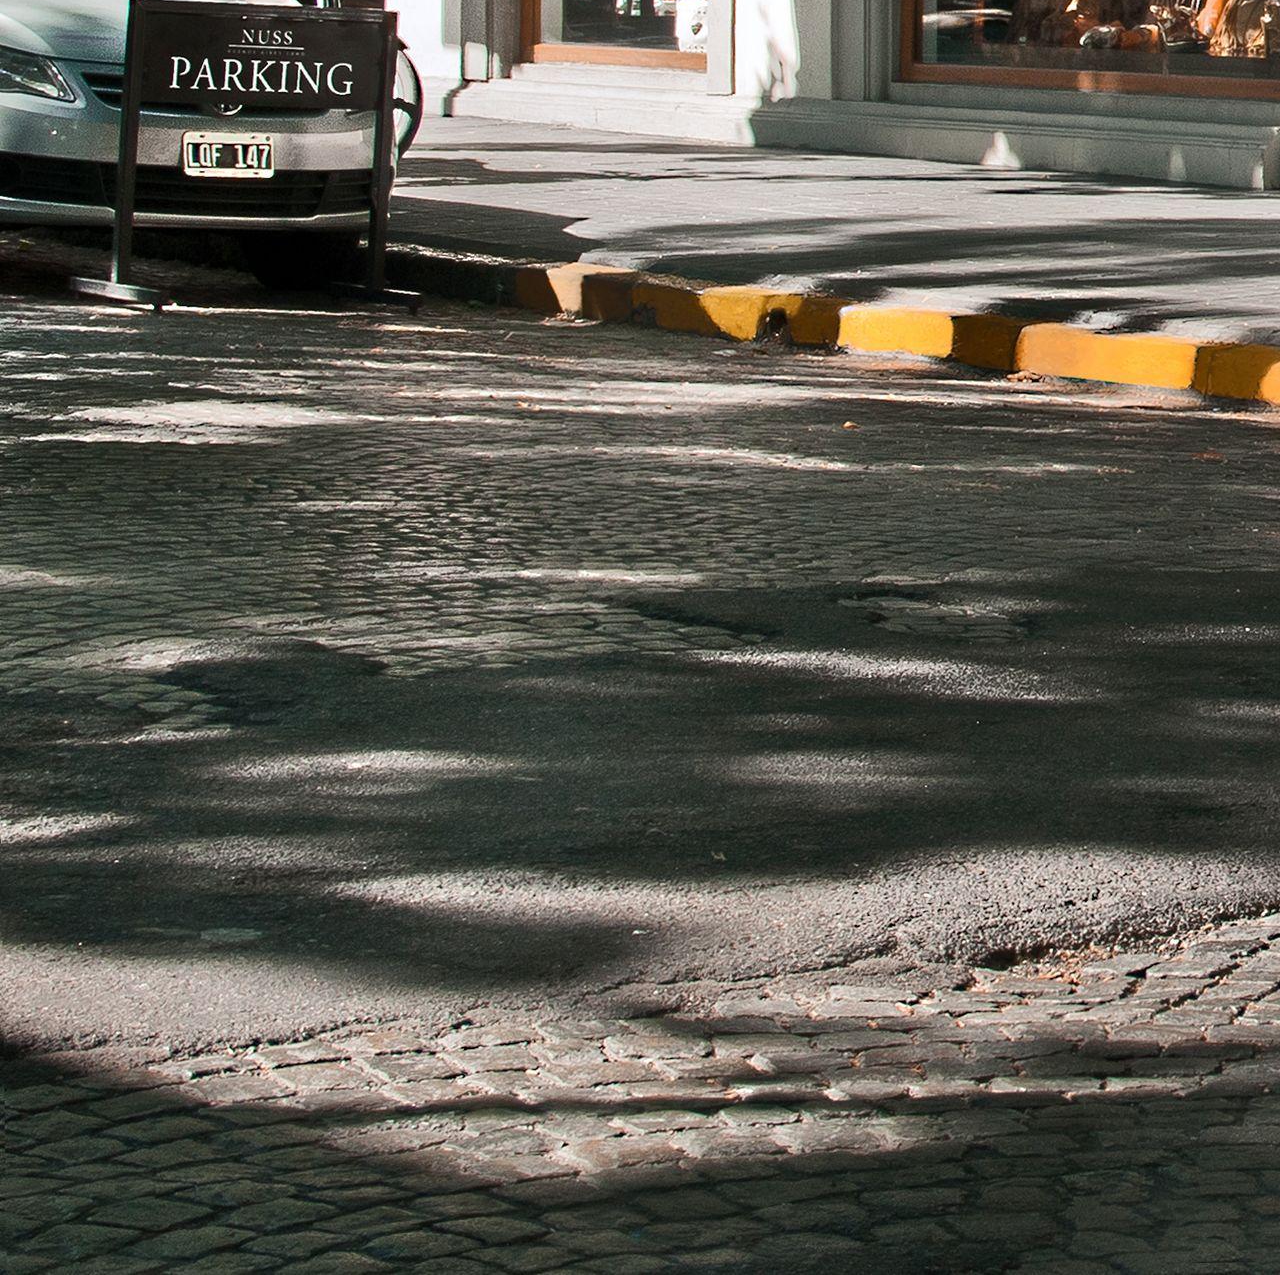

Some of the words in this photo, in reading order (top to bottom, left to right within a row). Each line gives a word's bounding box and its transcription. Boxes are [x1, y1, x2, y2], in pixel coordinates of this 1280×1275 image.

[241, 28, 293, 45] NUSS
[169, 56, 354, 96] PARKING
[234, 144, 270, 169] 147
